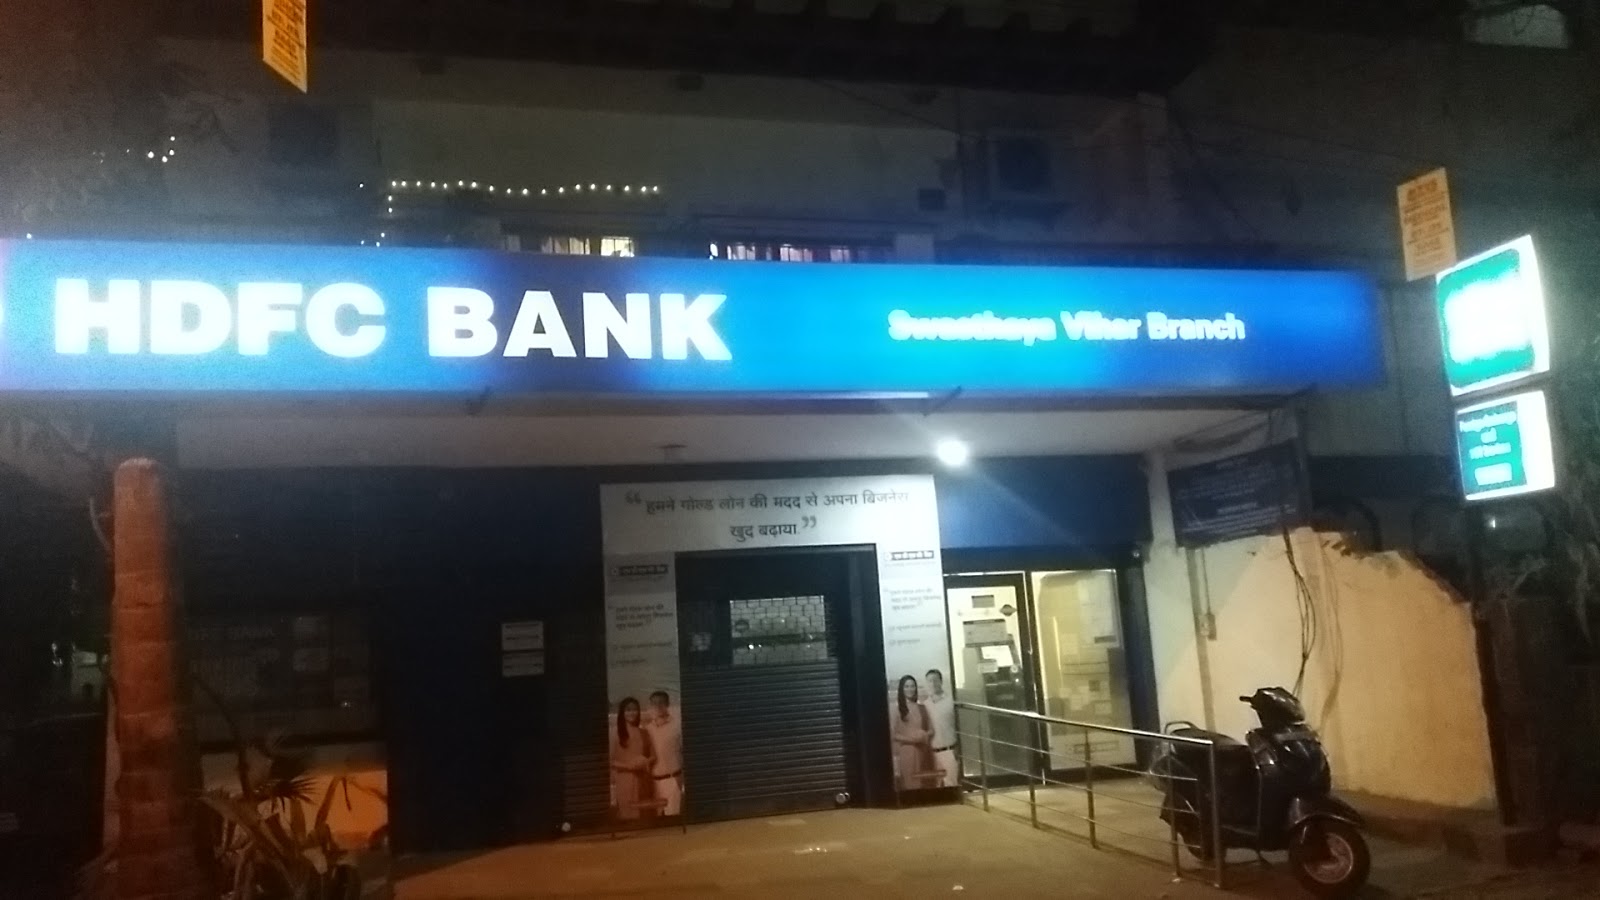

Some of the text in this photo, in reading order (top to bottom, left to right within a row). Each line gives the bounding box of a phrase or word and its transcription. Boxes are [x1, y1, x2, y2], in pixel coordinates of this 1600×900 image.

[53, 278, 732, 362] HDFC BANK
[1060, 310, 1142, 341] Vihar
[1146, 311, 1246, 341] Branch
[719, 495, 744, 510] लोन
[749, 493, 768, 509] की
[773, 496, 801, 509] मदद
[805, 491, 818, 507] से
[823, 493, 858, 507] अपना
[730, 524, 755, 542] खुद
